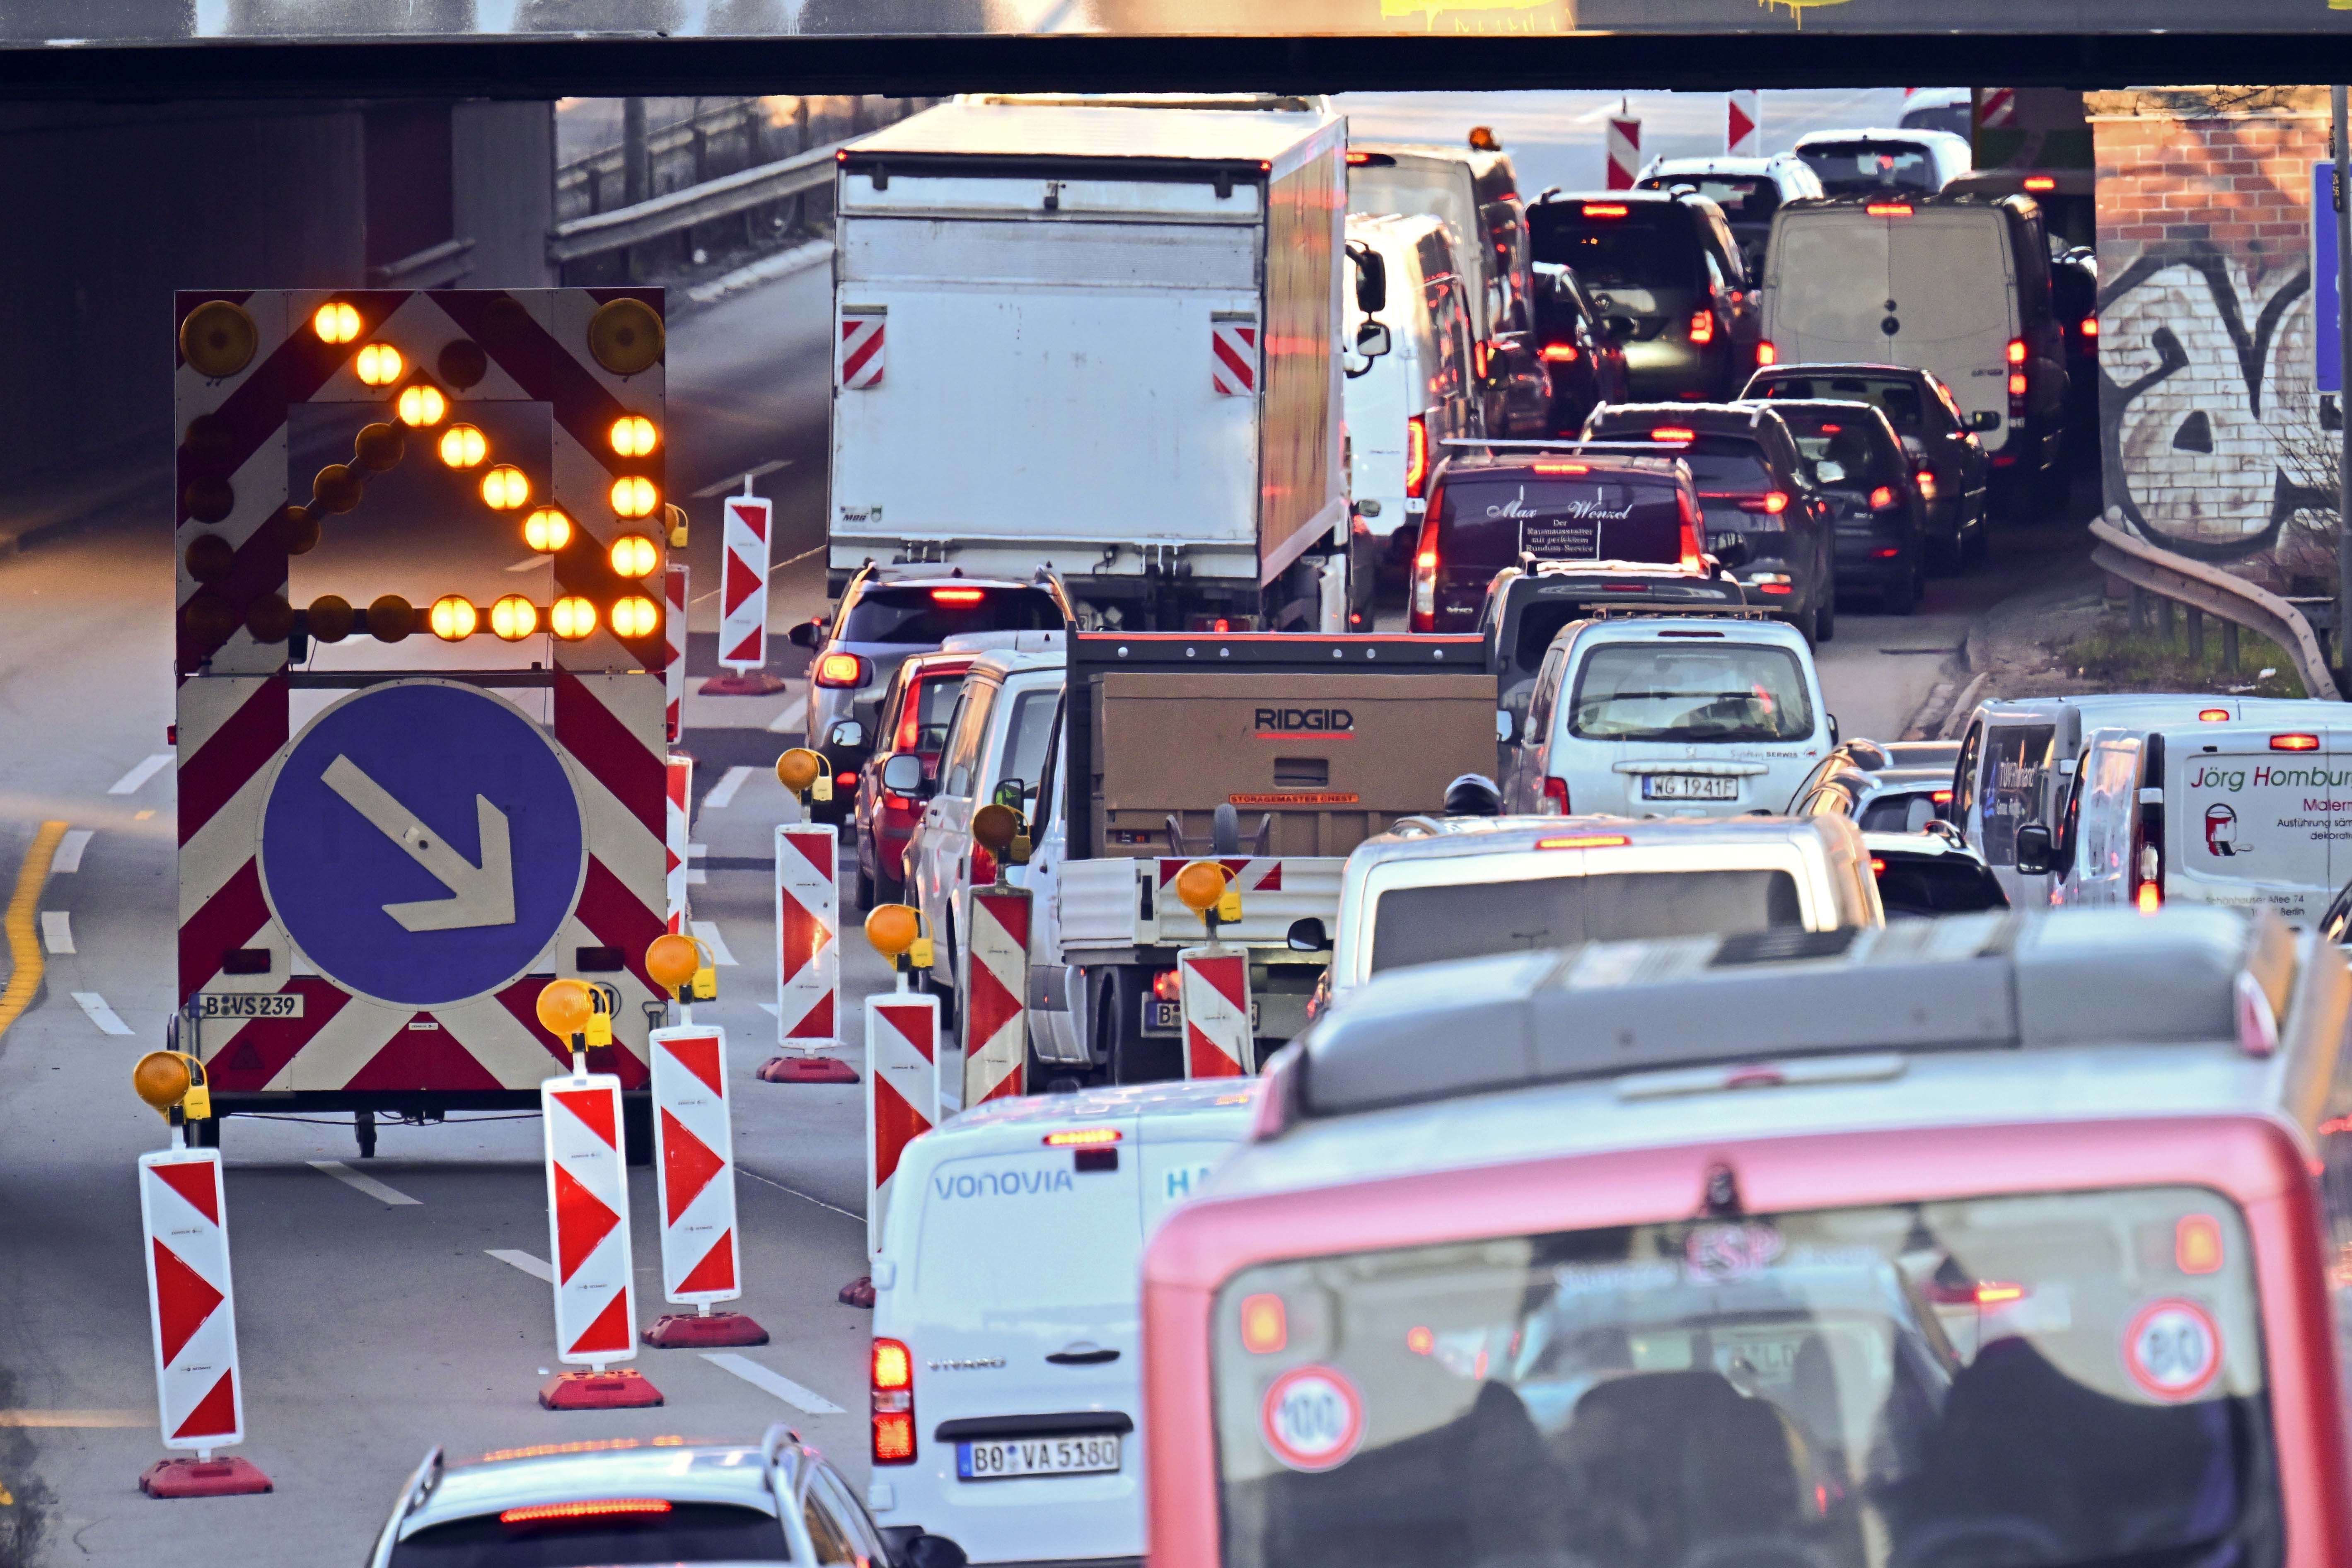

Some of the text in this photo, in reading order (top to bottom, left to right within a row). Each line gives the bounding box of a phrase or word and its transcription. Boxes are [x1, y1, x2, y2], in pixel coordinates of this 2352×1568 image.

[1487, 499, 1537, 518] Max
[1255, 708, 1354, 730] RIDGID
[1655, 776, 1733, 796] WG 1941F
[2190, 766, 2245, 792] Jörg
[1231, 795, 1318, 803] STORAGEMASTER
[2277, 817, 2331, 829] Ausführung
[2270, 894, 2290, 904] Allee
[2294, 894, 2304, 903] 74
[2280, 907, 2305, 916] Berlin
[260, 996, 295, 1015] 239
[2149, 1326, 2204, 1374] 80
[927, 1357, 1007, 1371] VIVARO
[1280, 1392, 1342, 1439] 100
[974, 1440, 1115, 1472] BO VA 5180
